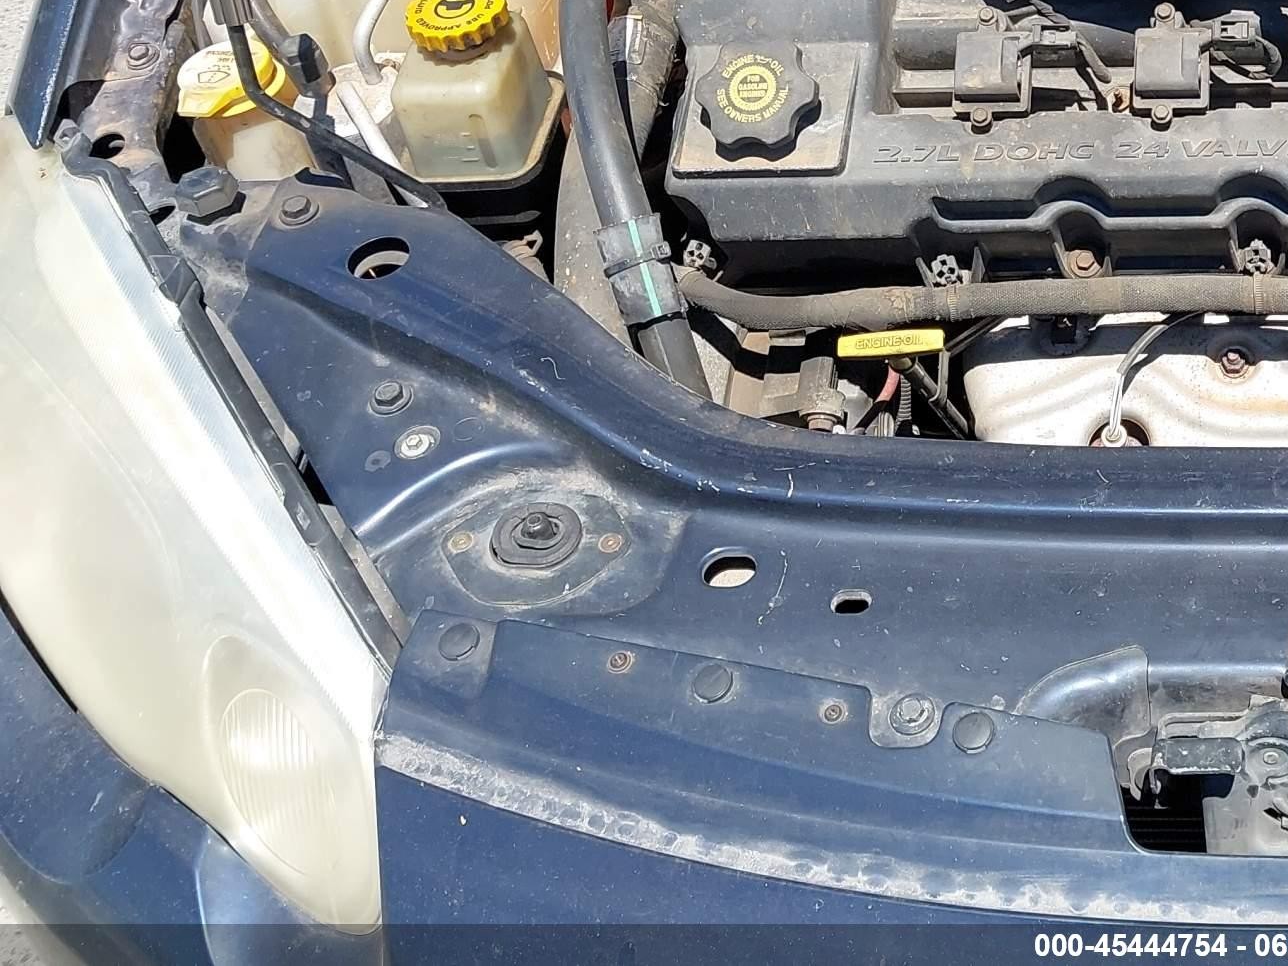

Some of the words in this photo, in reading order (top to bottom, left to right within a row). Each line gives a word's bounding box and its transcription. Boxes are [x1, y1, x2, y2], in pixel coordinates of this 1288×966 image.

[415, 17, 462, 31] APPROVED
[721, 54, 755, 79] ENGINE
[770, 60, 785, 77] OIL
[738, 82, 768, 91] GASOLINE
[716, 88, 729, 108] SEE
[724, 106, 763, 123] OWNERS
[762, 83, 789, 118] MANUAL
[872, 144, 960, 164] 2.7L
[972, 142, 1098, 162] DOHC
[1114, 140, 1171, 160] 24
[855, 335, 902, 350] ENGINE
